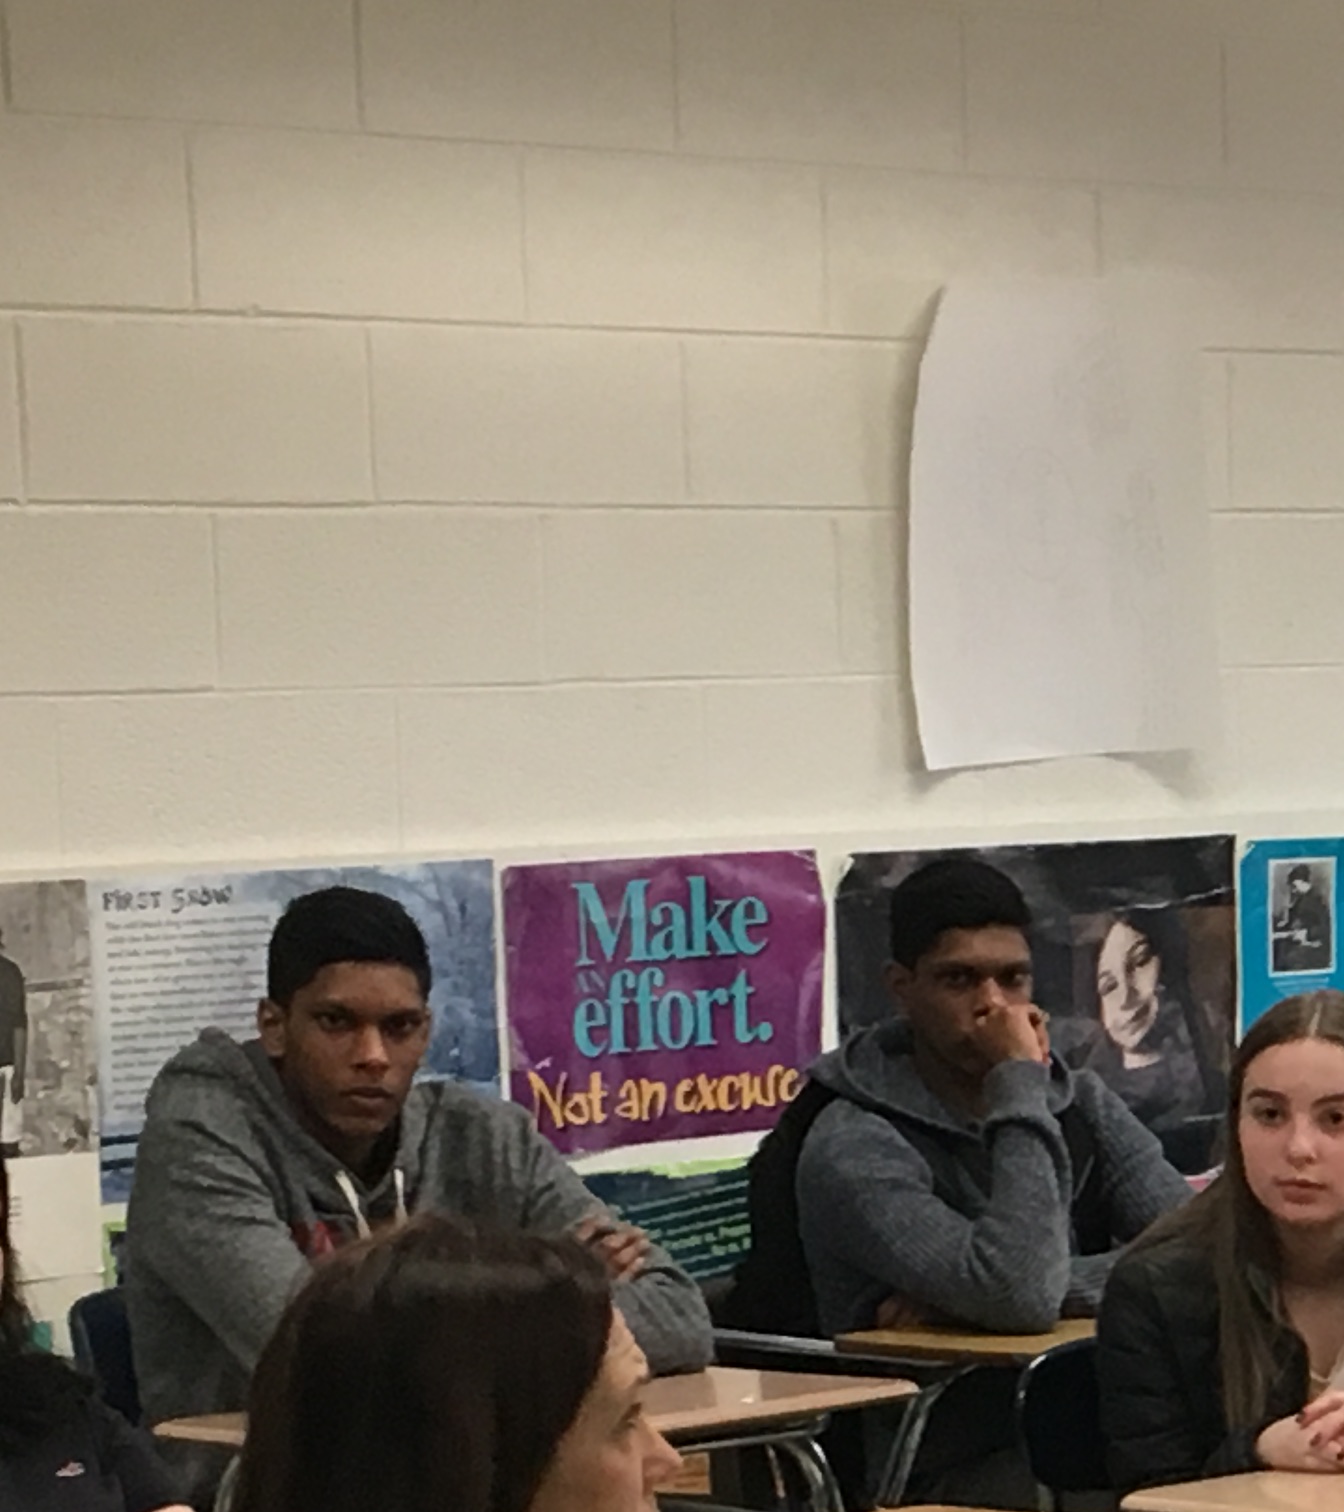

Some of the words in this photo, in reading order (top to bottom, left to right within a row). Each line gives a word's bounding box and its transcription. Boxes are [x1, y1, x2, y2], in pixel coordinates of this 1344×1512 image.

[570, 875, 769, 967] Make
[573, 967, 774, 1058] effort.
[528, 1070, 609, 1129] Not
[614, 1077, 667, 1121] an
